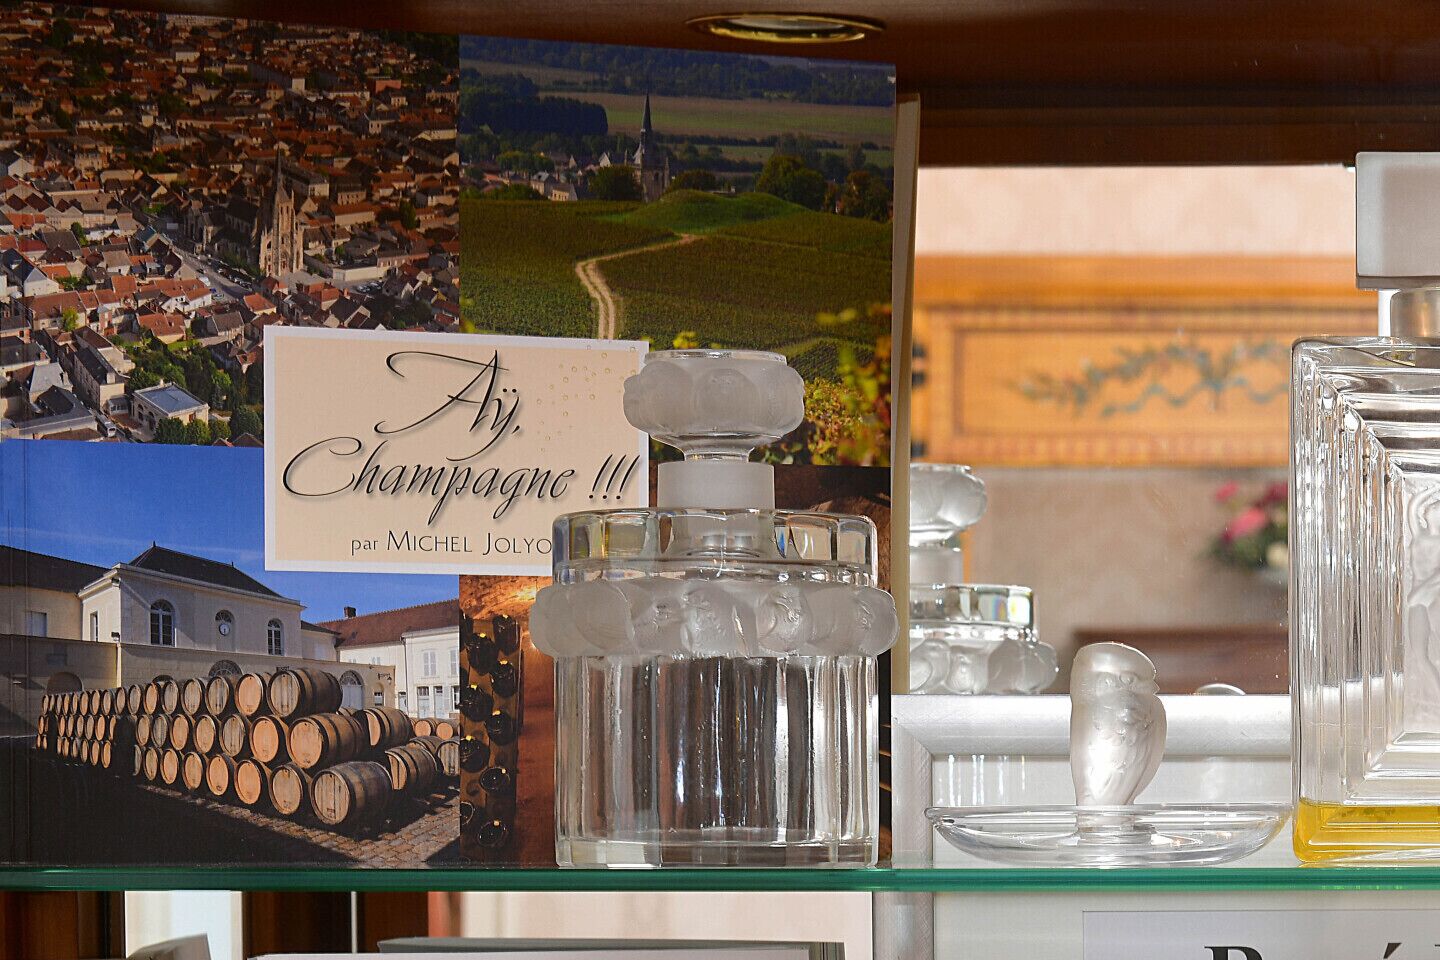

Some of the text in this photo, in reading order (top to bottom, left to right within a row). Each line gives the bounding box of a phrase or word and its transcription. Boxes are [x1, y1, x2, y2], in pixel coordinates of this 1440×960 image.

[374, 350, 523, 462] Aÿ,
[282, 436, 641, 526] Champagne !!!
[351, 530, 552, 556] par MICHEL JOLYO
